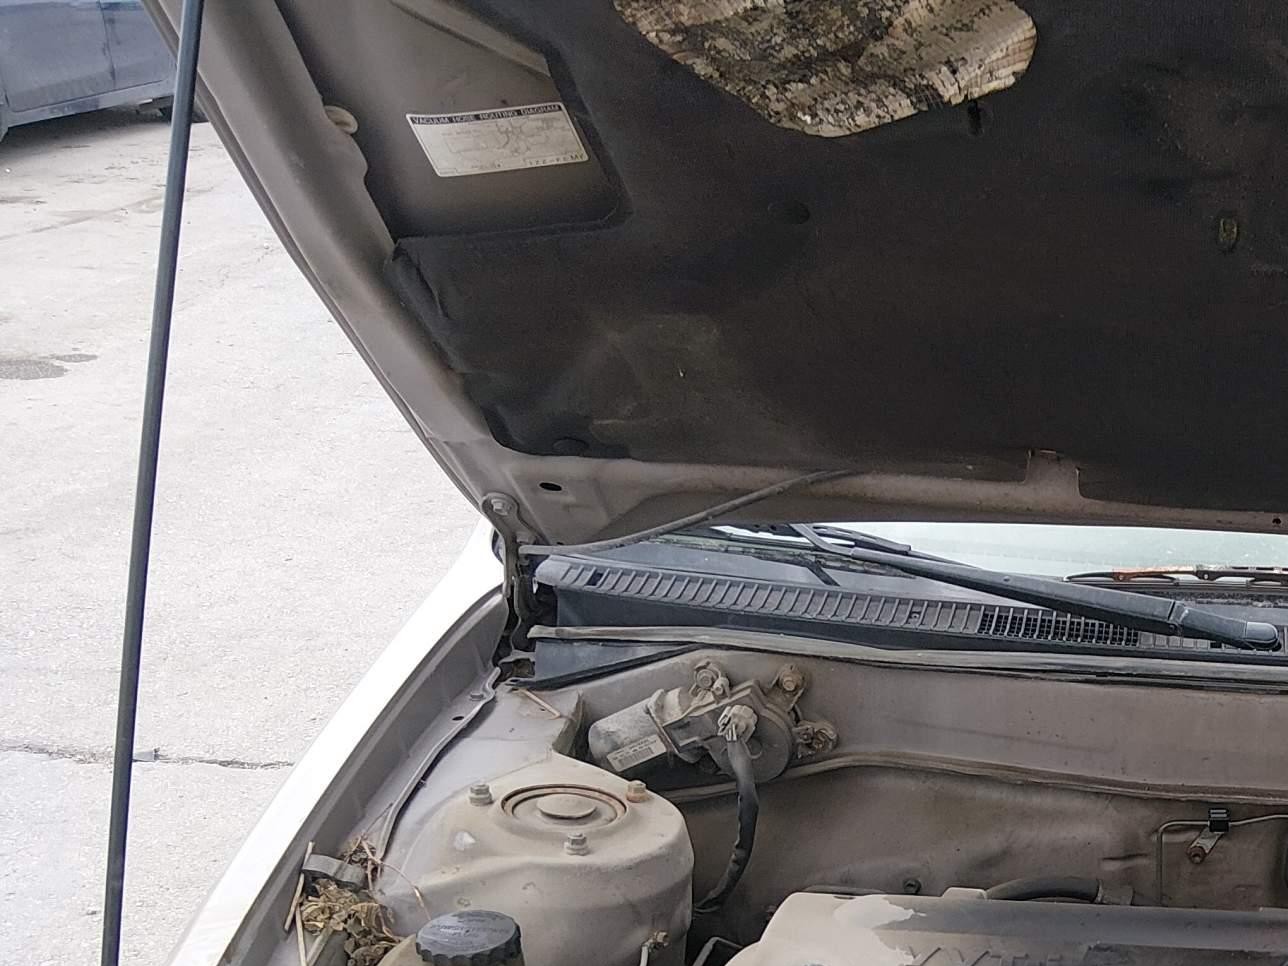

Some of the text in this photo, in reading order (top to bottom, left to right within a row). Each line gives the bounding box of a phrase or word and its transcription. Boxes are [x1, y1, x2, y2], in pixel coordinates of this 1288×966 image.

[411, 104, 560, 125] VACUUM HOSE ROUTING DIAGRAM
